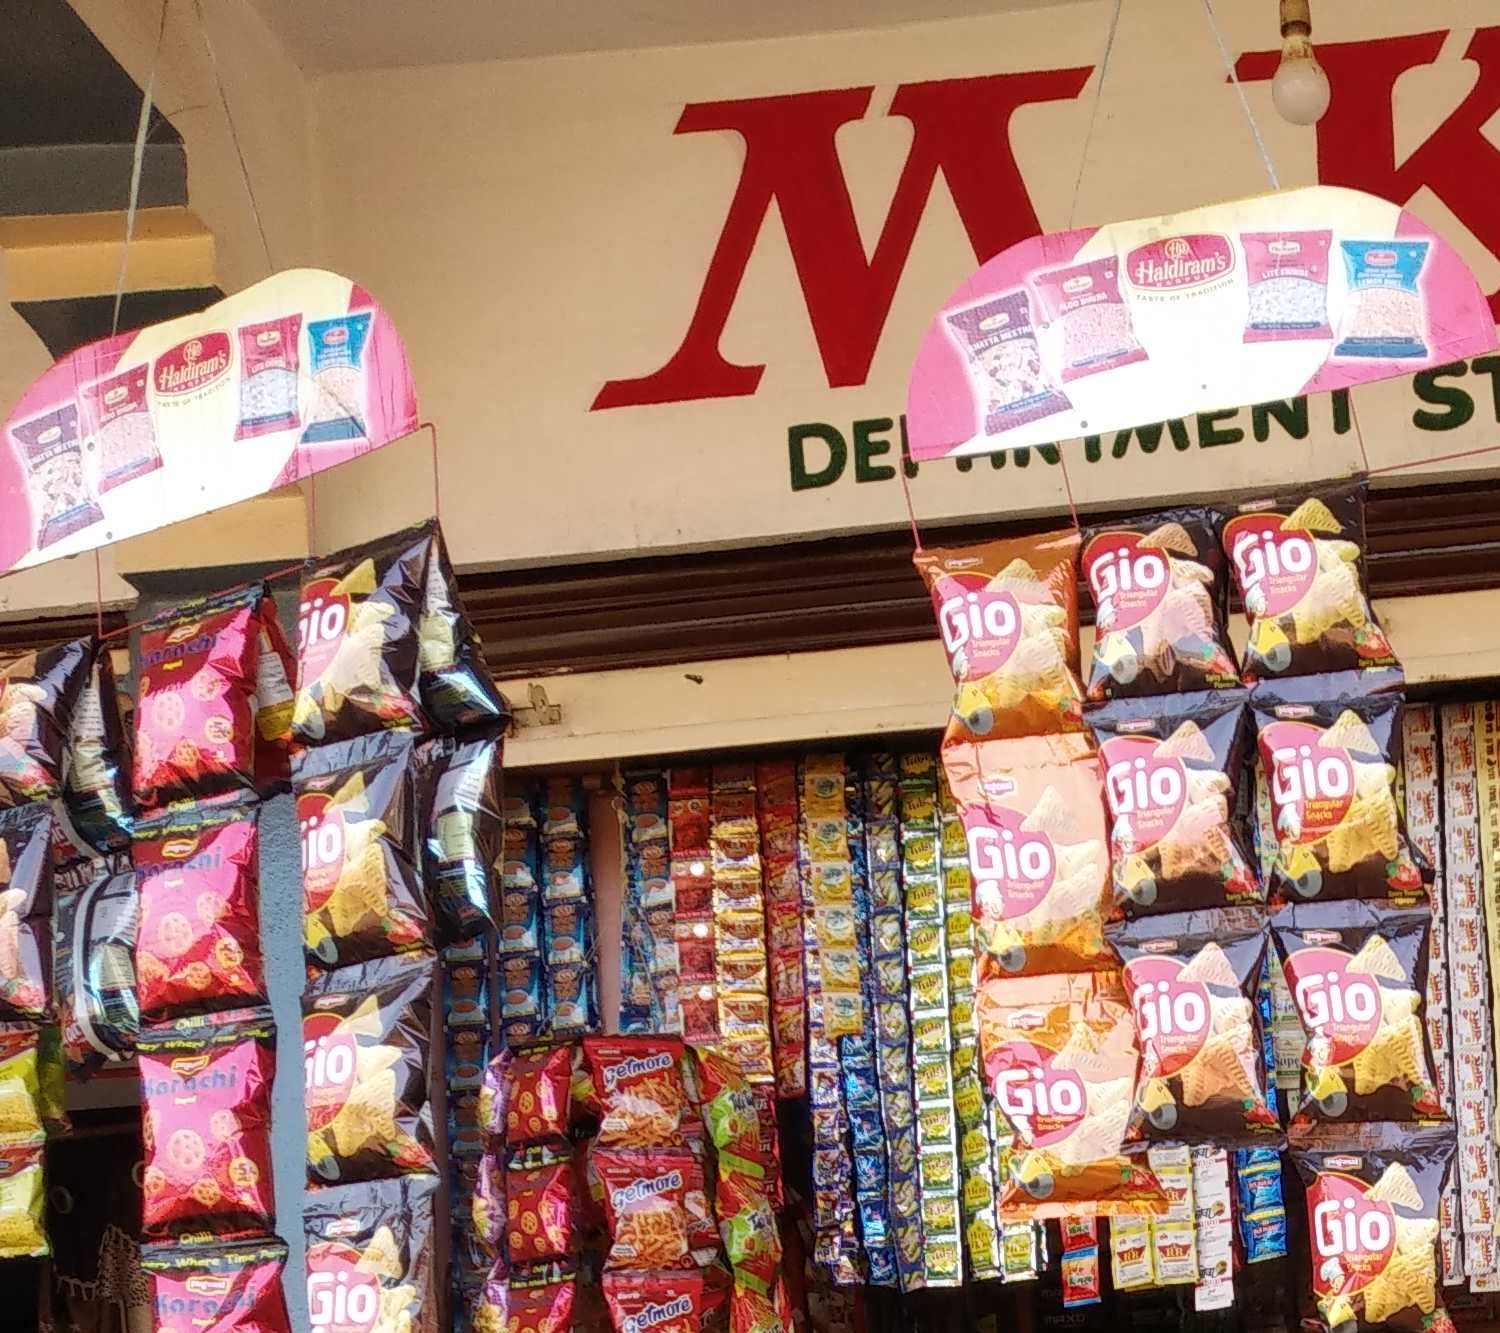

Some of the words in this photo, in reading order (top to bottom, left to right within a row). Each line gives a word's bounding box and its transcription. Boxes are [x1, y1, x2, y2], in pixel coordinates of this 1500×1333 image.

[588, 65, 1095, 409] M
[1135, 251, 1226, 285] Haldiram's
[161, 349, 227, 390] Haldiram's
[1090, 547, 1166, 596] Gio
[1233, 531, 1312, 588] Gio
[940, 594, 1017, 654] Gio
[1107, 757, 1183, 811] Gio
[1272, 747, 1351, 805] Gio
[969, 825, 1051, 879] Gio
[1132, 984, 1204, 1041] Gio
[1294, 974, 1377, 1030] Gio
[999, 1069, 1082, 1128] Gio
[1314, 1199, 1391, 1255] Gio
[307, 1271, 377, 1325] Gio
